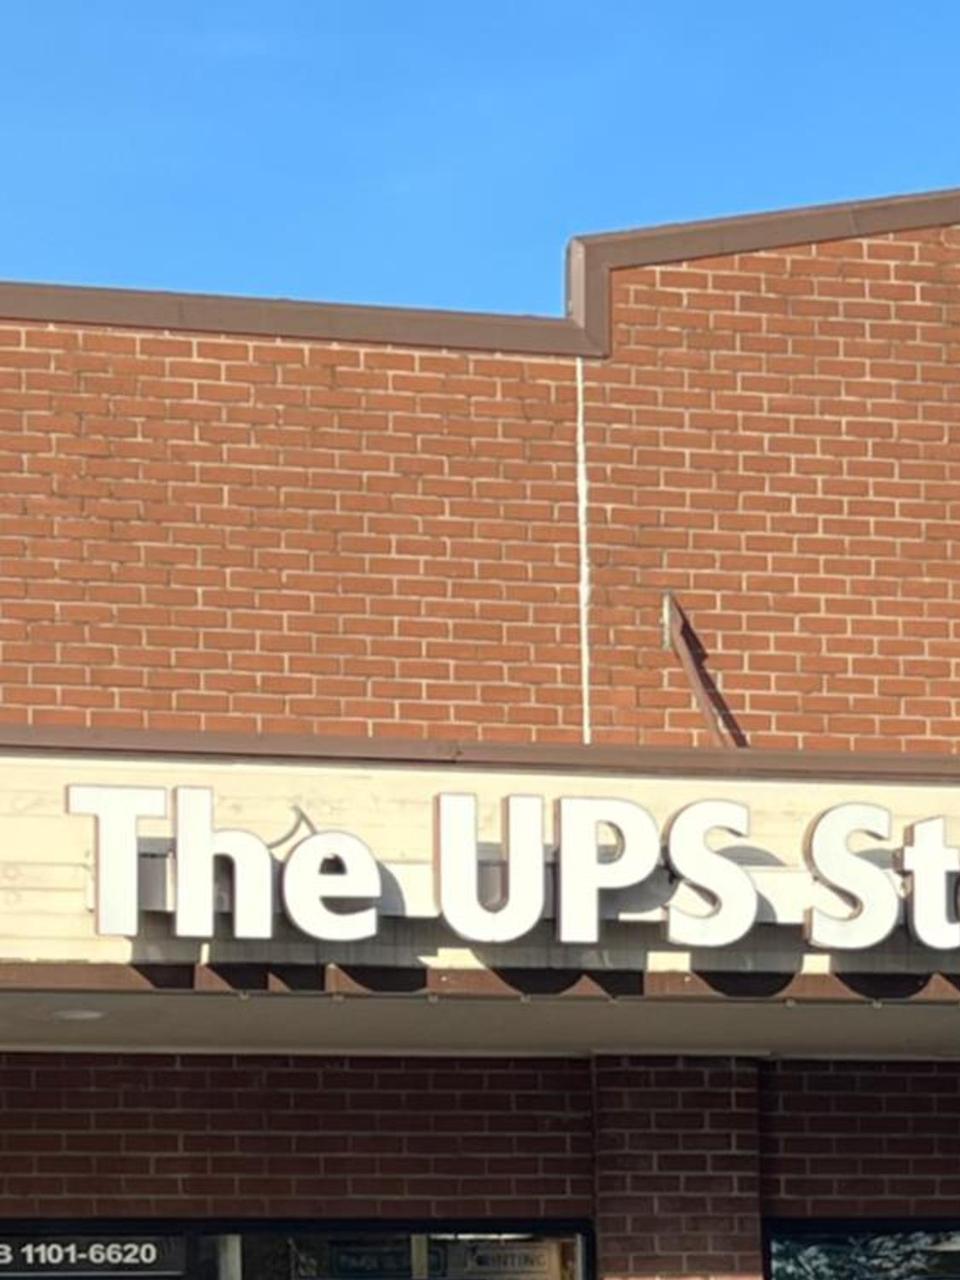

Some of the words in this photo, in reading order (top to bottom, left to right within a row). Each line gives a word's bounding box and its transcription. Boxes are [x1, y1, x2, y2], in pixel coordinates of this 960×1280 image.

[67, 784, 382, 941] The
[434, 791, 758, 948] UPS
[21, 1243, 157, 1264] 1101-6620
